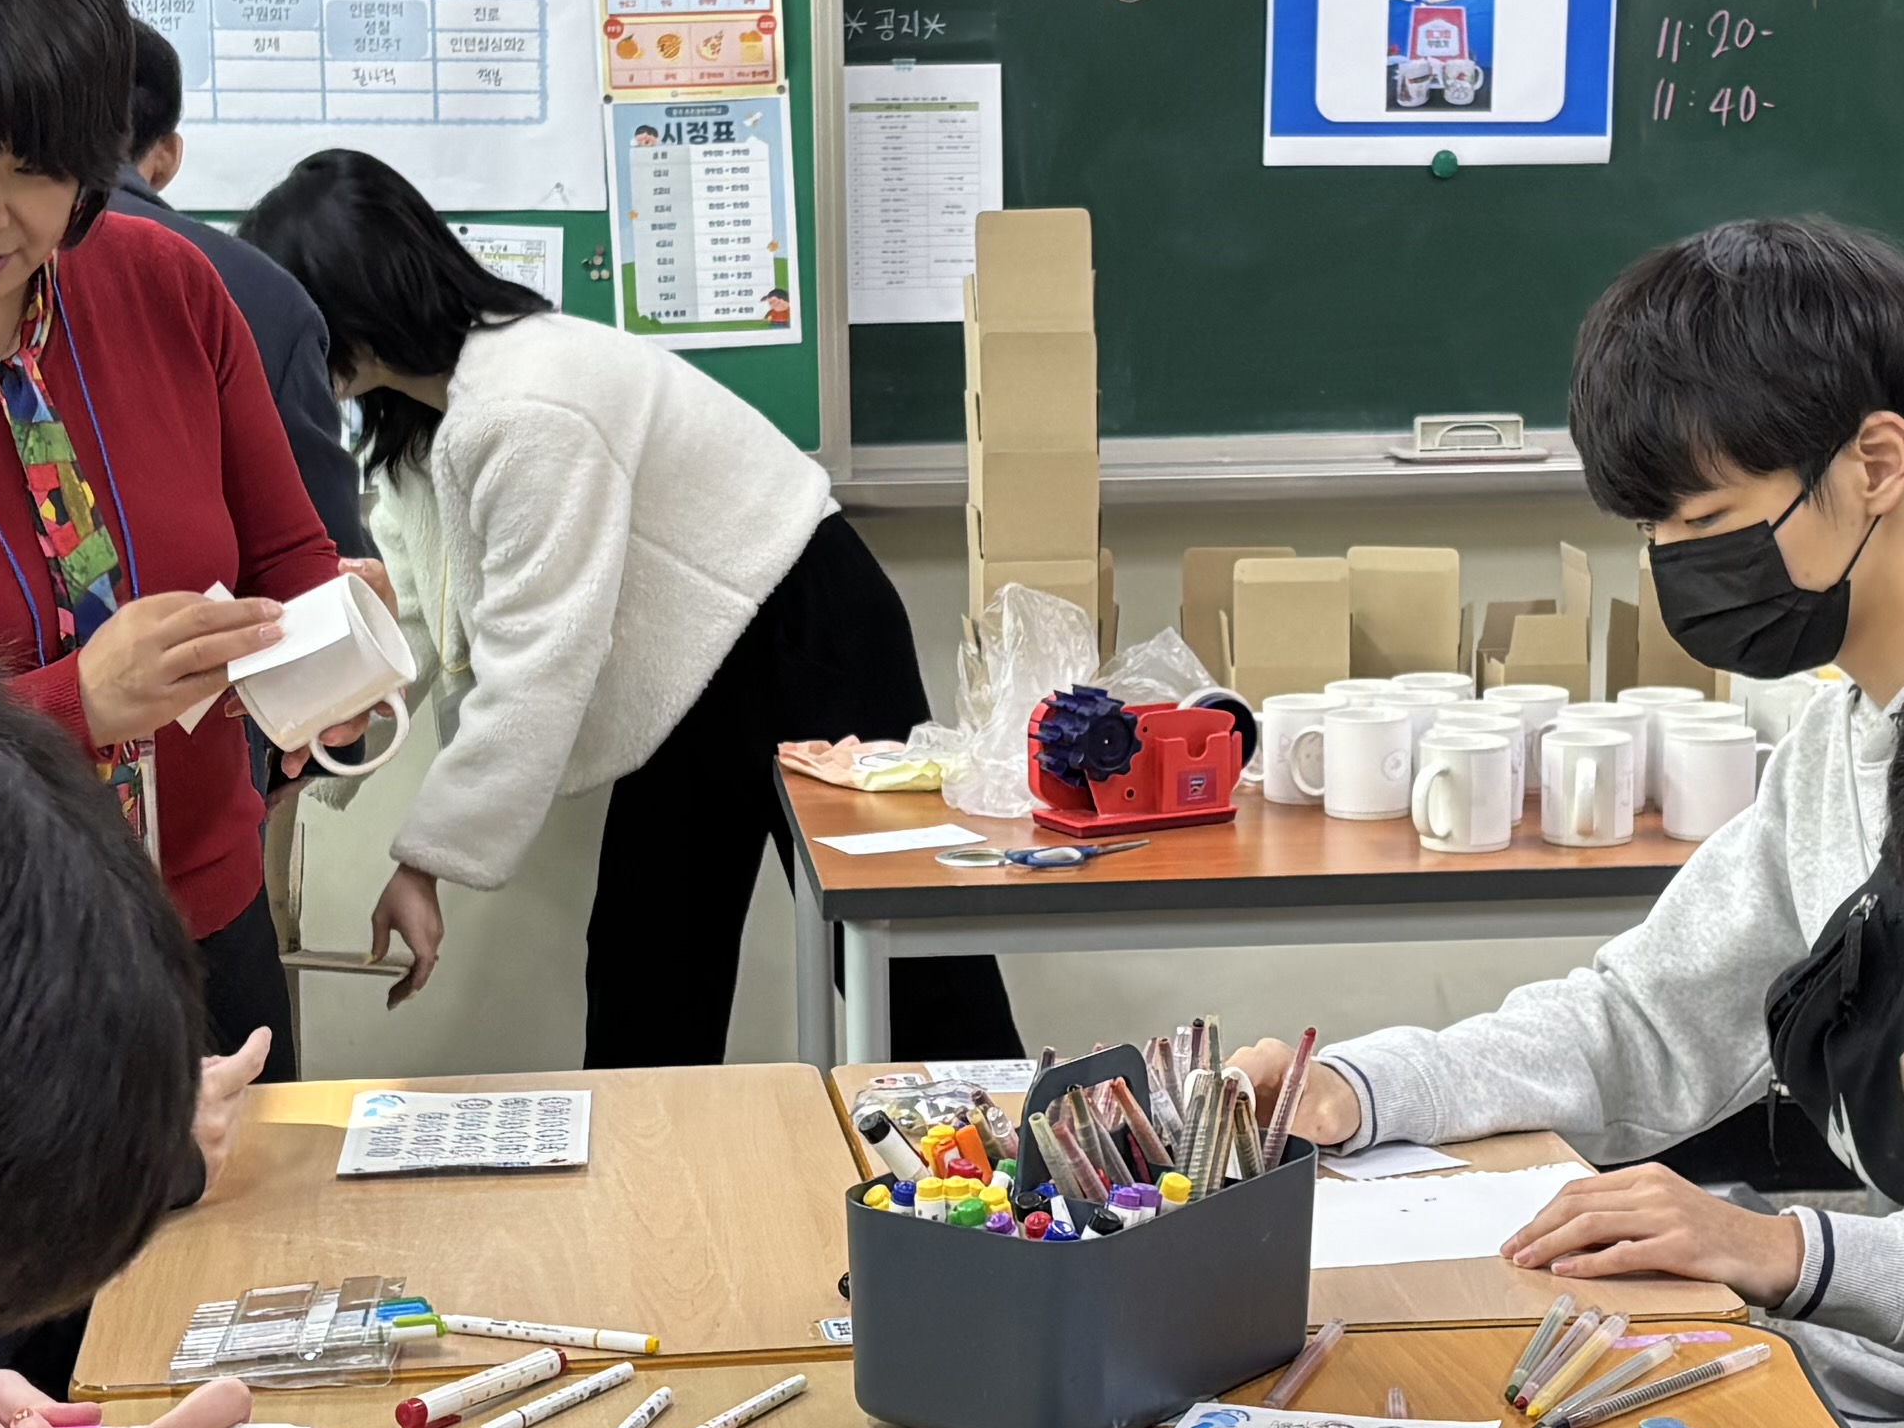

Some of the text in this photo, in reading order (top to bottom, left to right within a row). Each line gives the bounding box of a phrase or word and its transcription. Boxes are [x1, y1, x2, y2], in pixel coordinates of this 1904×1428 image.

[350, 3, 404, 18] 인문학적
[474, 7, 500, 22] 진로
[364, 20, 390, 35] 성찰
[254, 36, 280, 52] 창체
[450, 37, 525, 53] 인턴십심화2
[661, 120, 736, 146] 시정표
